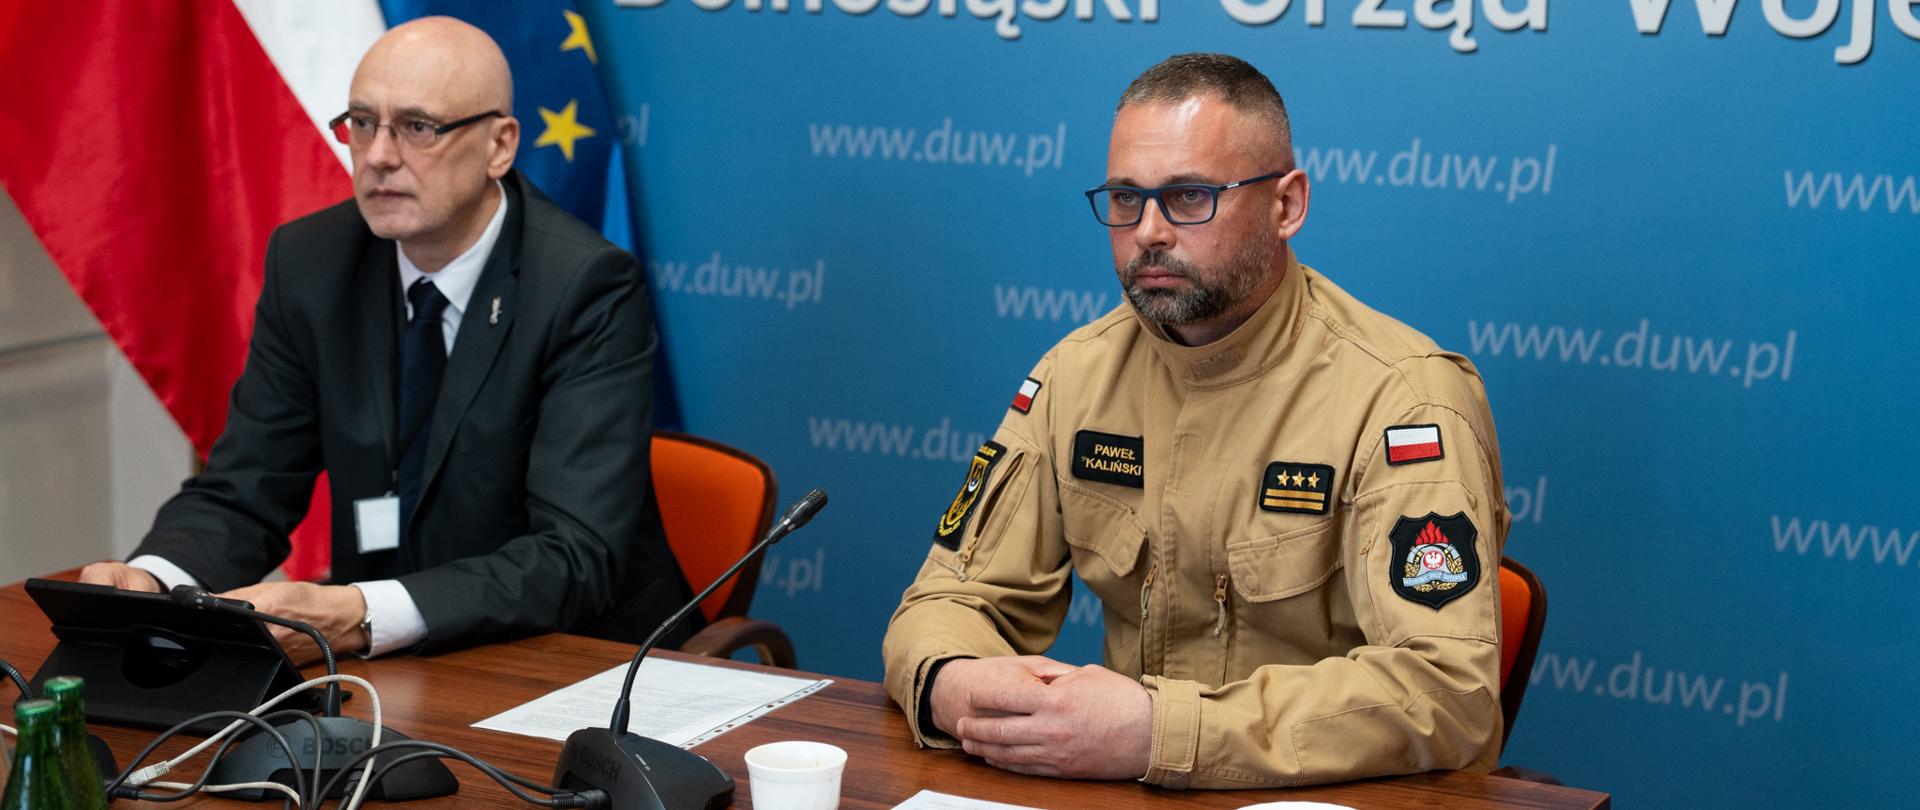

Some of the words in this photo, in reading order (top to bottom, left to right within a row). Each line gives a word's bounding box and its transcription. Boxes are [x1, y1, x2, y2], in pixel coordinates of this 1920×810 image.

[810, 117, 1067, 177] www.duw.pl
[1468, 319, 1797, 389] www.duw.pl
[809, 416, 986, 464] www.du
[1094, 444, 1136, 460] PAWEŁ
[1085, 457, 1142, 476] KALIŃSKI
[1770, 515, 1920, 567] www
